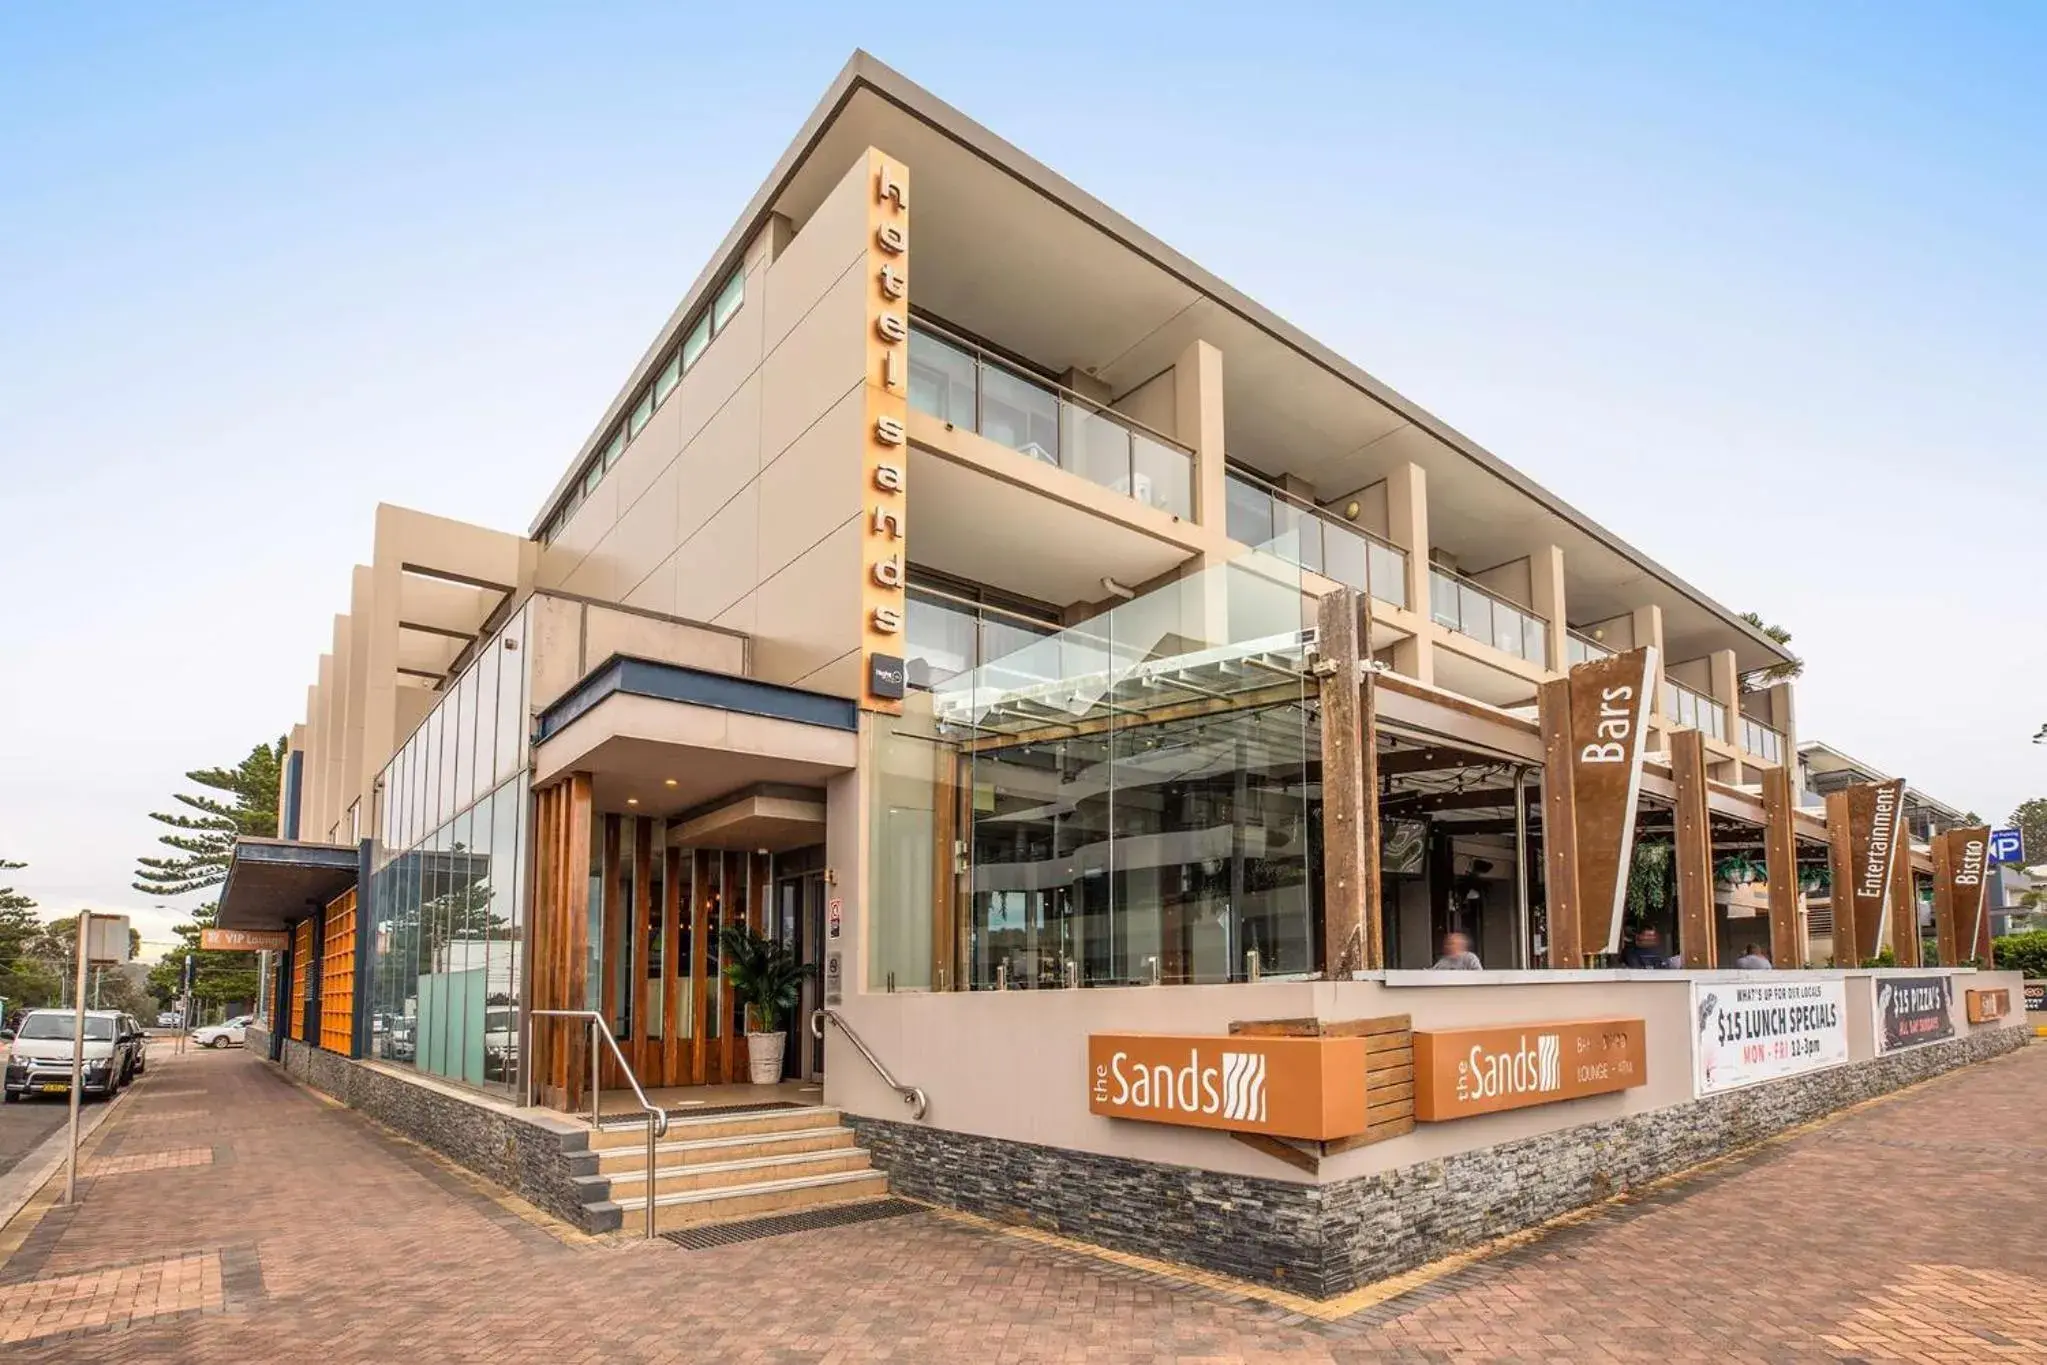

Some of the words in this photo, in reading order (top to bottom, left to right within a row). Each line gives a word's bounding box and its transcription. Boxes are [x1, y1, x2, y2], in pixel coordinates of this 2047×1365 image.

[877, 163, 906, 386] hotel
[874, 415, 904, 634] sands
[1581, 686, 1632, 762] Bars
[1857, 787, 1896, 898] Entertainment
[1955, 840, 1984, 885] Bistro
[1998, 838, 2019, 860] P
[225, 932, 245, 944] VIP
[1736, 987, 1762, 1002] WHAT'S
[1764, 987, 1773, 1001] UP
[1774, 987, 1786, 1000] FOR
[1801, 985, 1822, 998] LOCALS
[1893, 985, 1909, 1018] $15
[1911, 986, 1941, 1012] PIZZA'S
[1718, 1008, 1742, 1047] $15
[1745, 1007, 1787, 1038] LUNCH
[1790, 1003, 1837, 1033] SPECIALS
[1456, 1059, 1469, 1101] the
[1469, 1034, 1539, 1101] Sands
[1743, 1044, 1765, 1064] MON
[1774, 1040, 1789, 1060] FRI
[1791, 1037, 1820, 1058] 12-3pm
[1093, 1064, 1108, 1103] the
[1111, 1047, 1220, 1115] Sands
